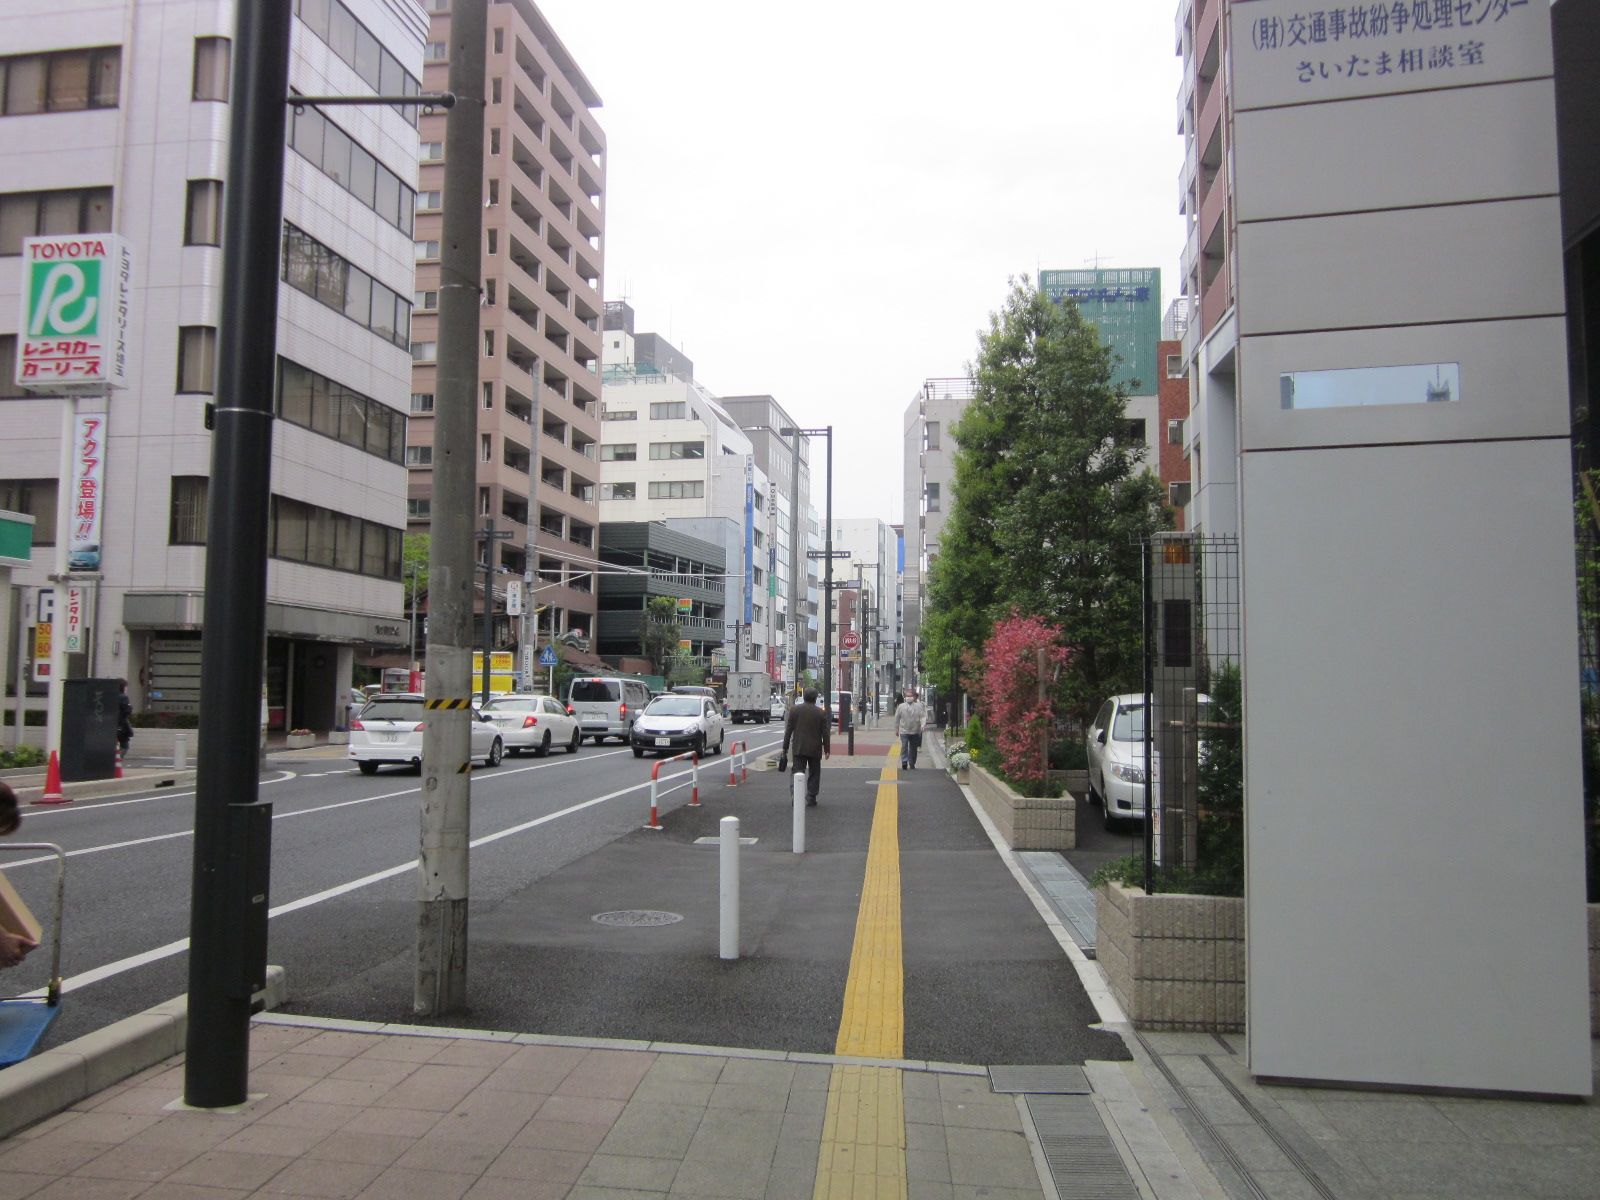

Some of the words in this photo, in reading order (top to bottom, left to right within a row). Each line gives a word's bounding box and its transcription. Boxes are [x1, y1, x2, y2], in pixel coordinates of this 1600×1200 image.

[1252, 0, 1529, 50] (財)交通事故紛争処理センター
[1297, 40, 1485, 83] さいたま相談室
[30, 241, 106, 259] TOYOTA
[23, 340, 101, 356] レンタカー
[22, 361, 100, 377] カーリース
[69, 589, 79, 632] レンタカー
